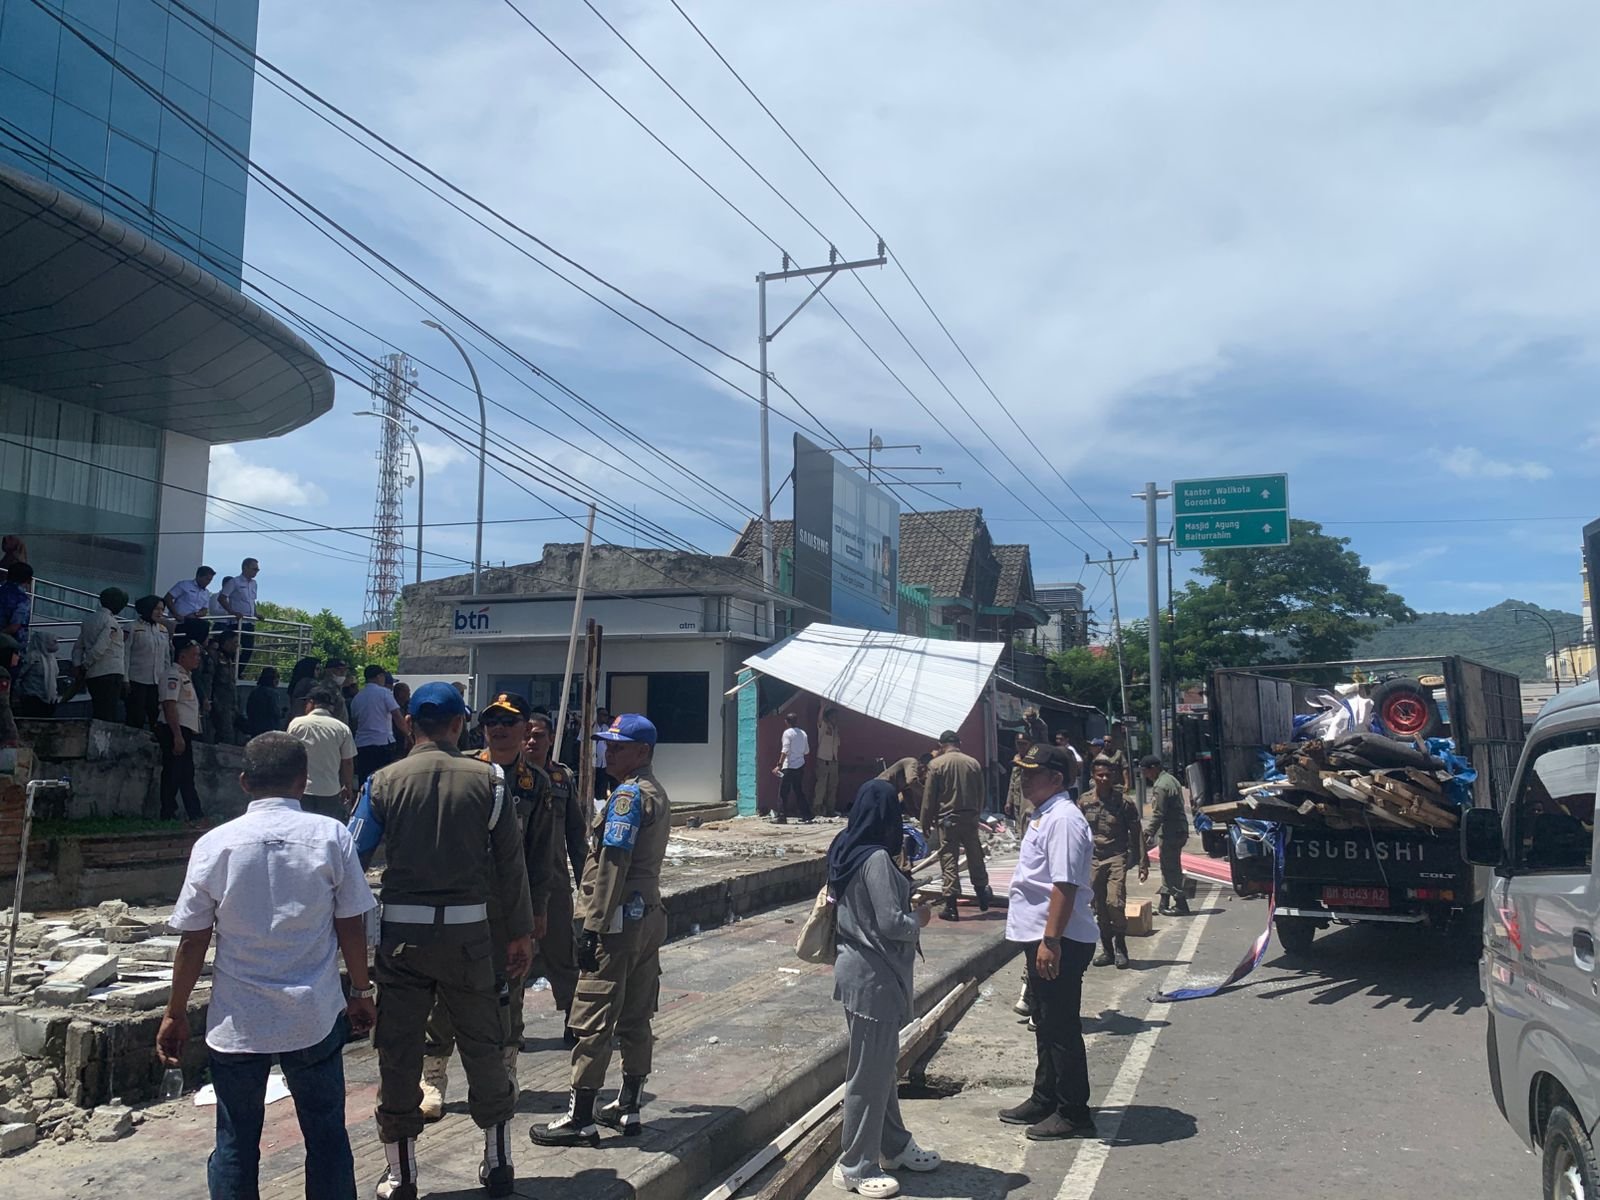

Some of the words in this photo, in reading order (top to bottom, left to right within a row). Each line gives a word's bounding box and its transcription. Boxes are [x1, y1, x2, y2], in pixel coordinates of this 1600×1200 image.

[1184, 488, 1211, 497] Kantor
[1215, 485, 1251, 495] Walikota
[1184, 497, 1227, 507] Gorontalo
[1184, 521, 1210, 531] Masjid
[1215, 520, 1240, 529] Agung
[799, 528, 829, 555] SAMSUNG
[1184, 531, 1232, 541] Baiturrahim
[455, 607, 490, 630] btn
[1262, 840, 1424, 861] MTSUBISHI
[1372, 889, 1385, 901] AZ
